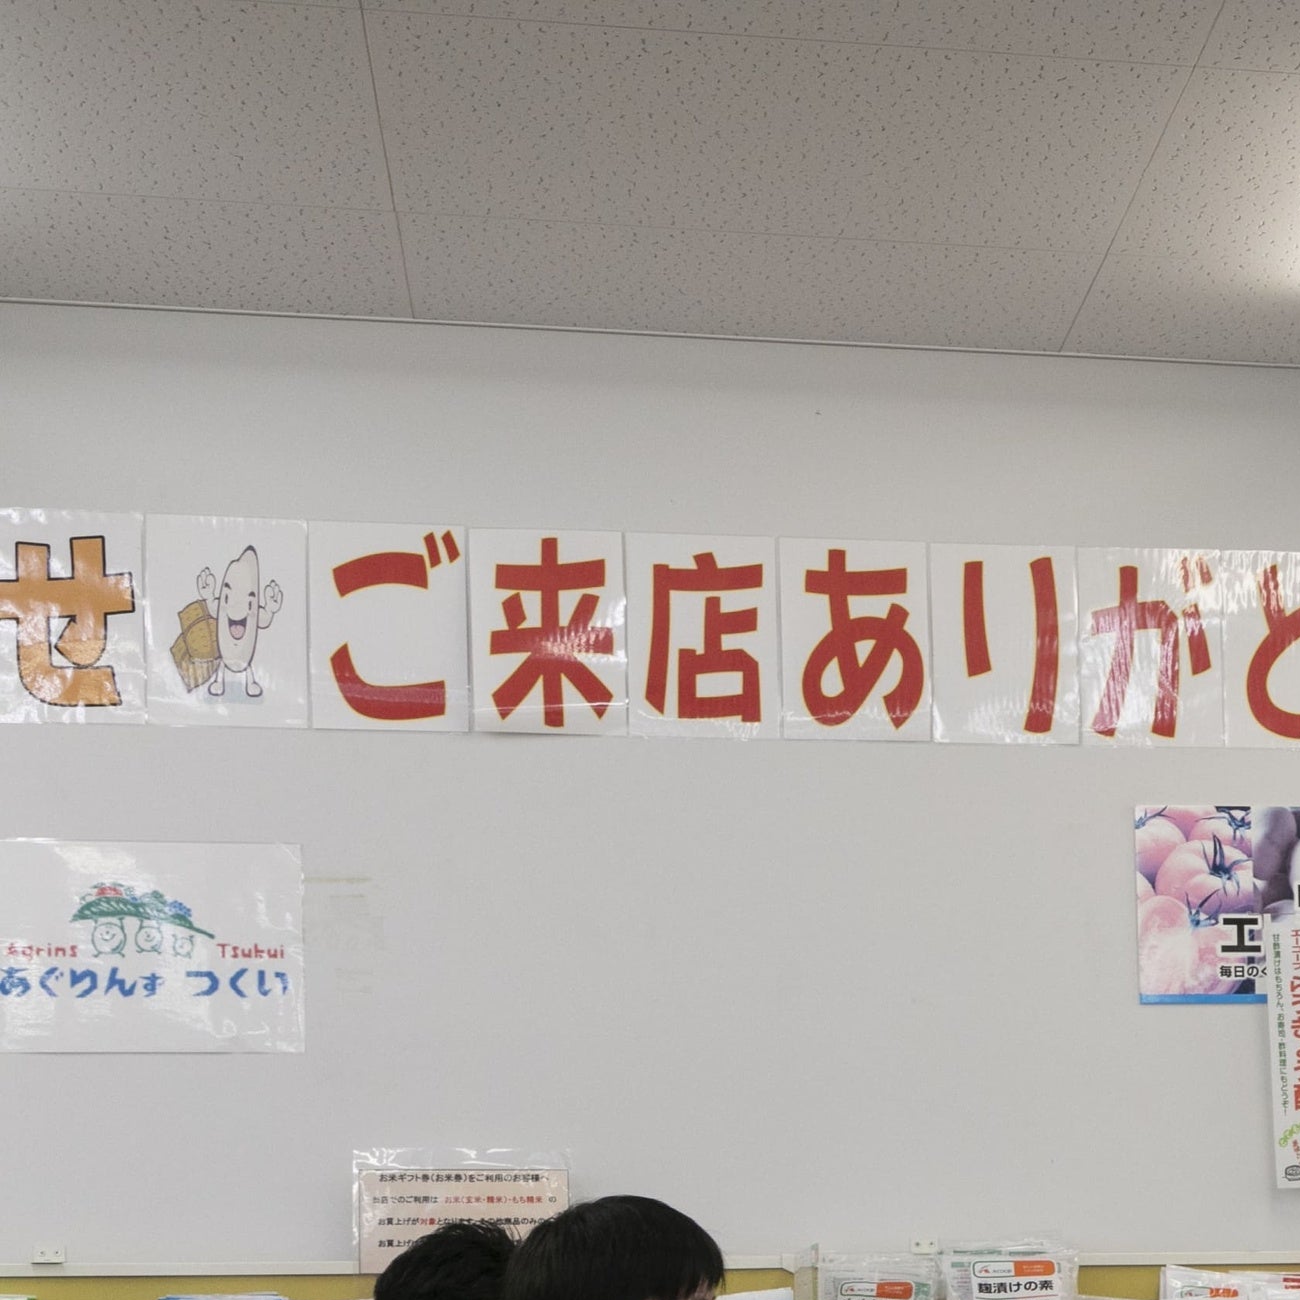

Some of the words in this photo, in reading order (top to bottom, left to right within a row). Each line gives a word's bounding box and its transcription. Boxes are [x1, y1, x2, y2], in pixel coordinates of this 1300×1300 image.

[217, 942, 286, 960] Tsukui
[186, 966, 289, 998] つくい
[978, 1280, 1054, 1294] 麹漬けの素
